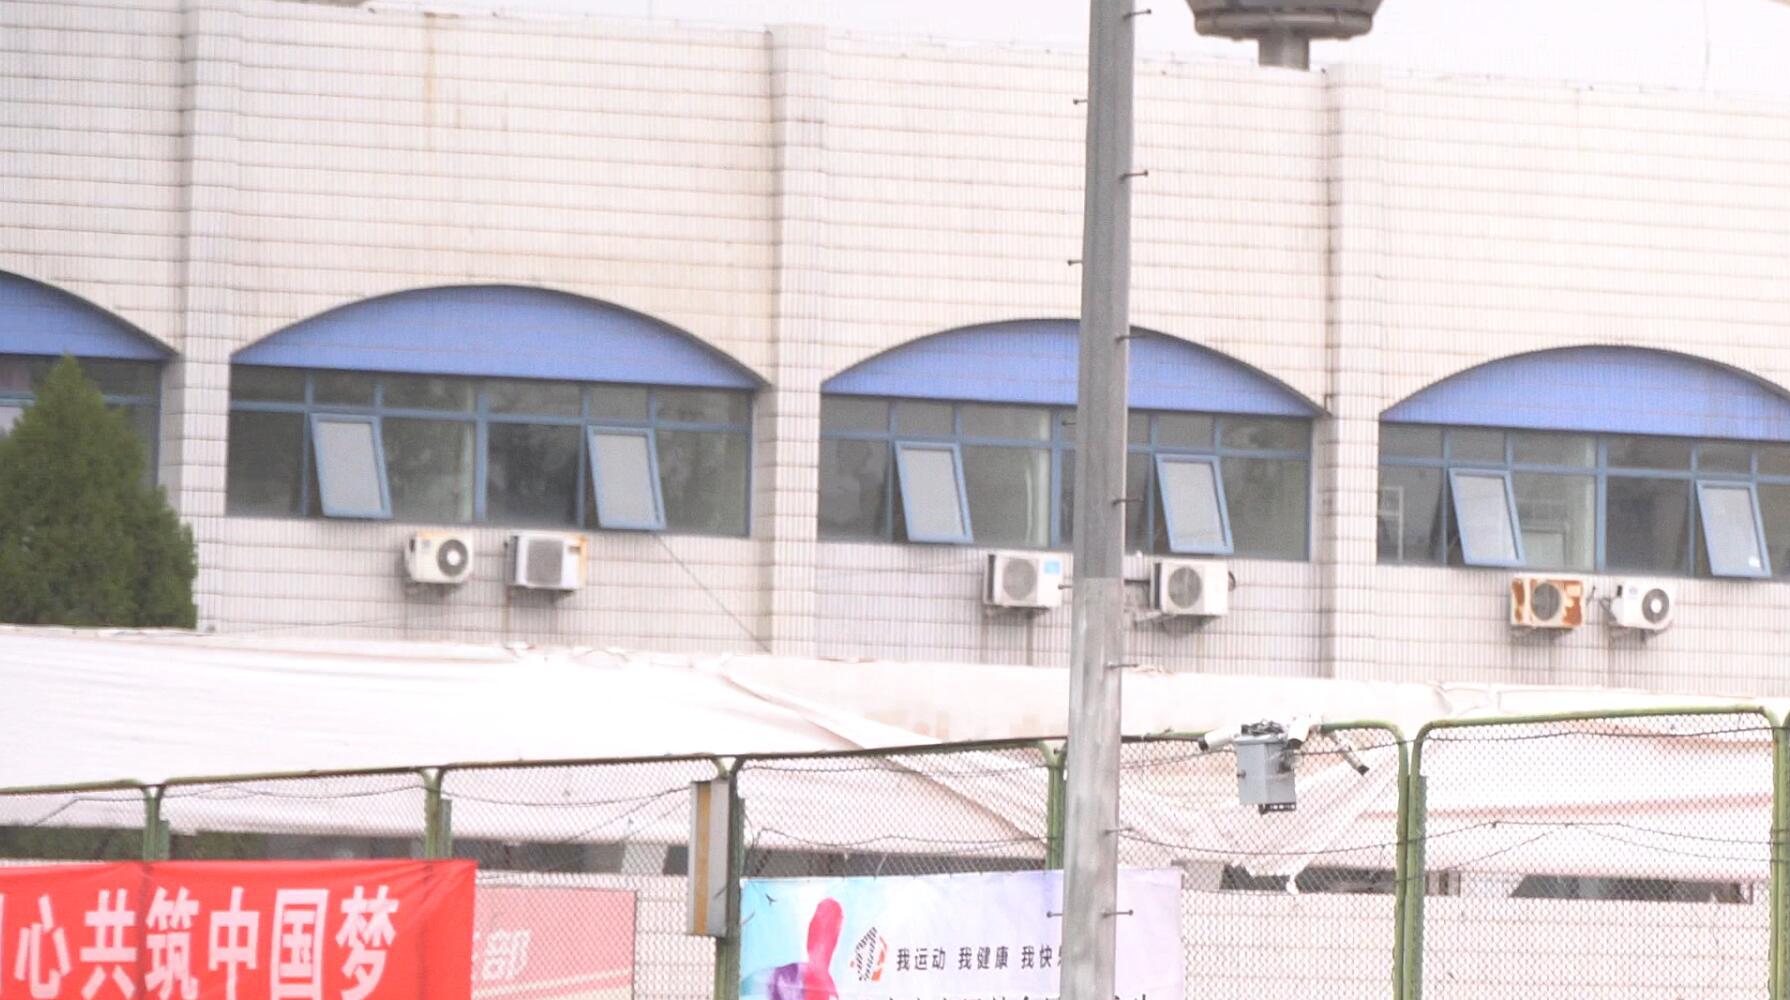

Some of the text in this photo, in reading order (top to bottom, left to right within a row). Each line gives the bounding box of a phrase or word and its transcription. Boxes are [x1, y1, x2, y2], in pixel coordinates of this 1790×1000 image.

[896, 944, 1062, 971] 我运动 我健康 我快
